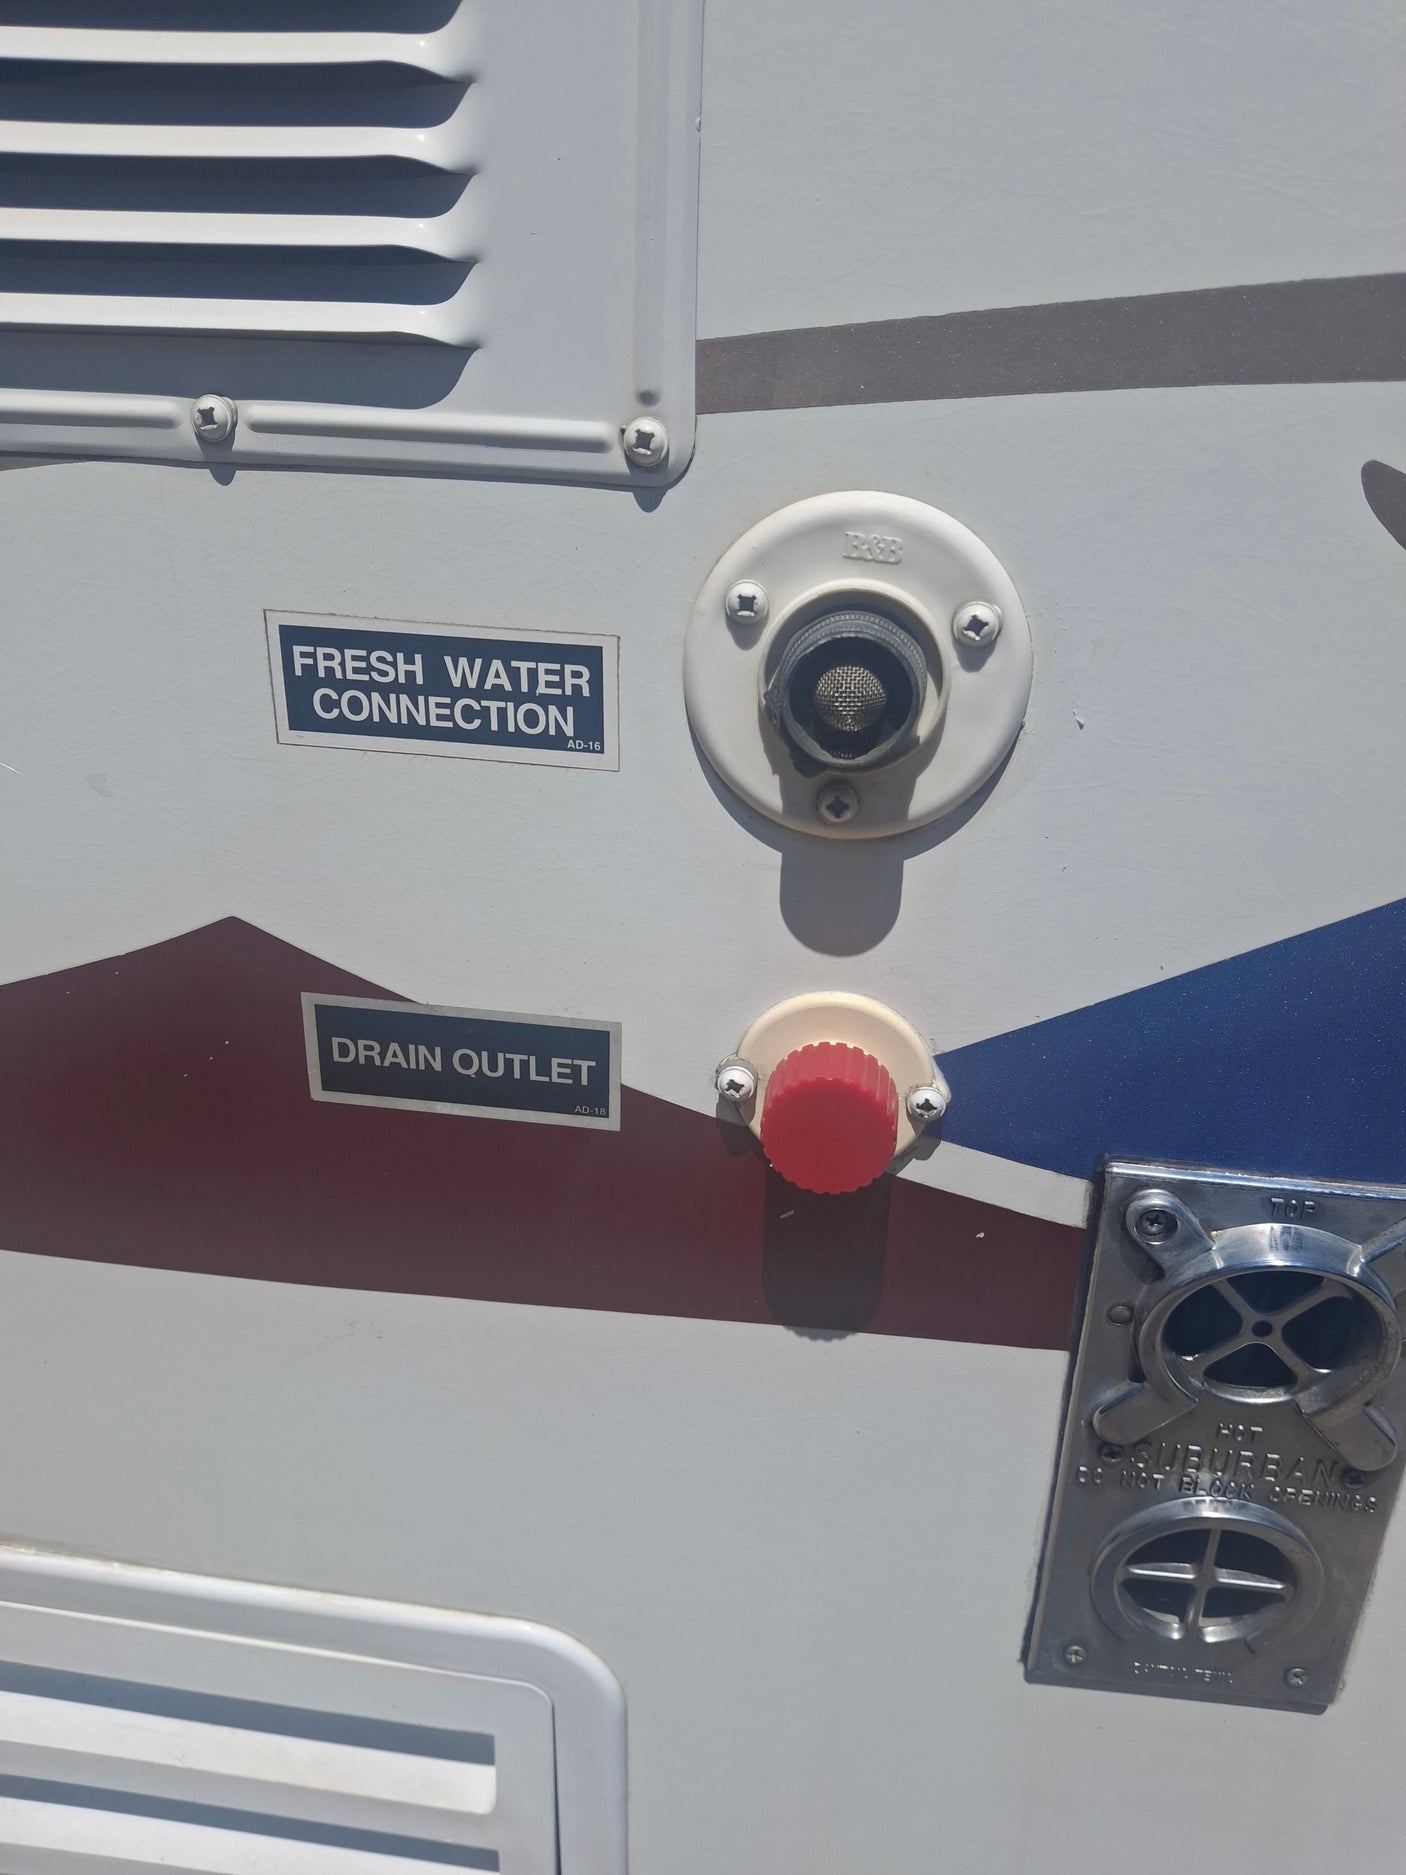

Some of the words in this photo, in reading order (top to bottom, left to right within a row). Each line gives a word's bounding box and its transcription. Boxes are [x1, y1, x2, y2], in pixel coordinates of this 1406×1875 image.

[292, 645, 424, 685] FRESH
[444, 655, 591, 697] WATER
[313, 687, 575, 737] CONNECTION
[567, 739, 602, 751] AD-16
[331, 1036, 442, 1072] DRAIN
[574, 1104, 607, 1116] AD-18
[1269, 1196, 1316, 1219] TOP
[1216, 1421, 1264, 1443] HOT
[1130, 1441, 1340, 1489] SUBURBAN
[1076, 1465, 1104, 1486] DO
[1121, 1470, 1165, 1491] NOT
[1178, 1475, 1255, 1501] BLOCK
[1268, 1485, 1379, 1514] OPENINGS
